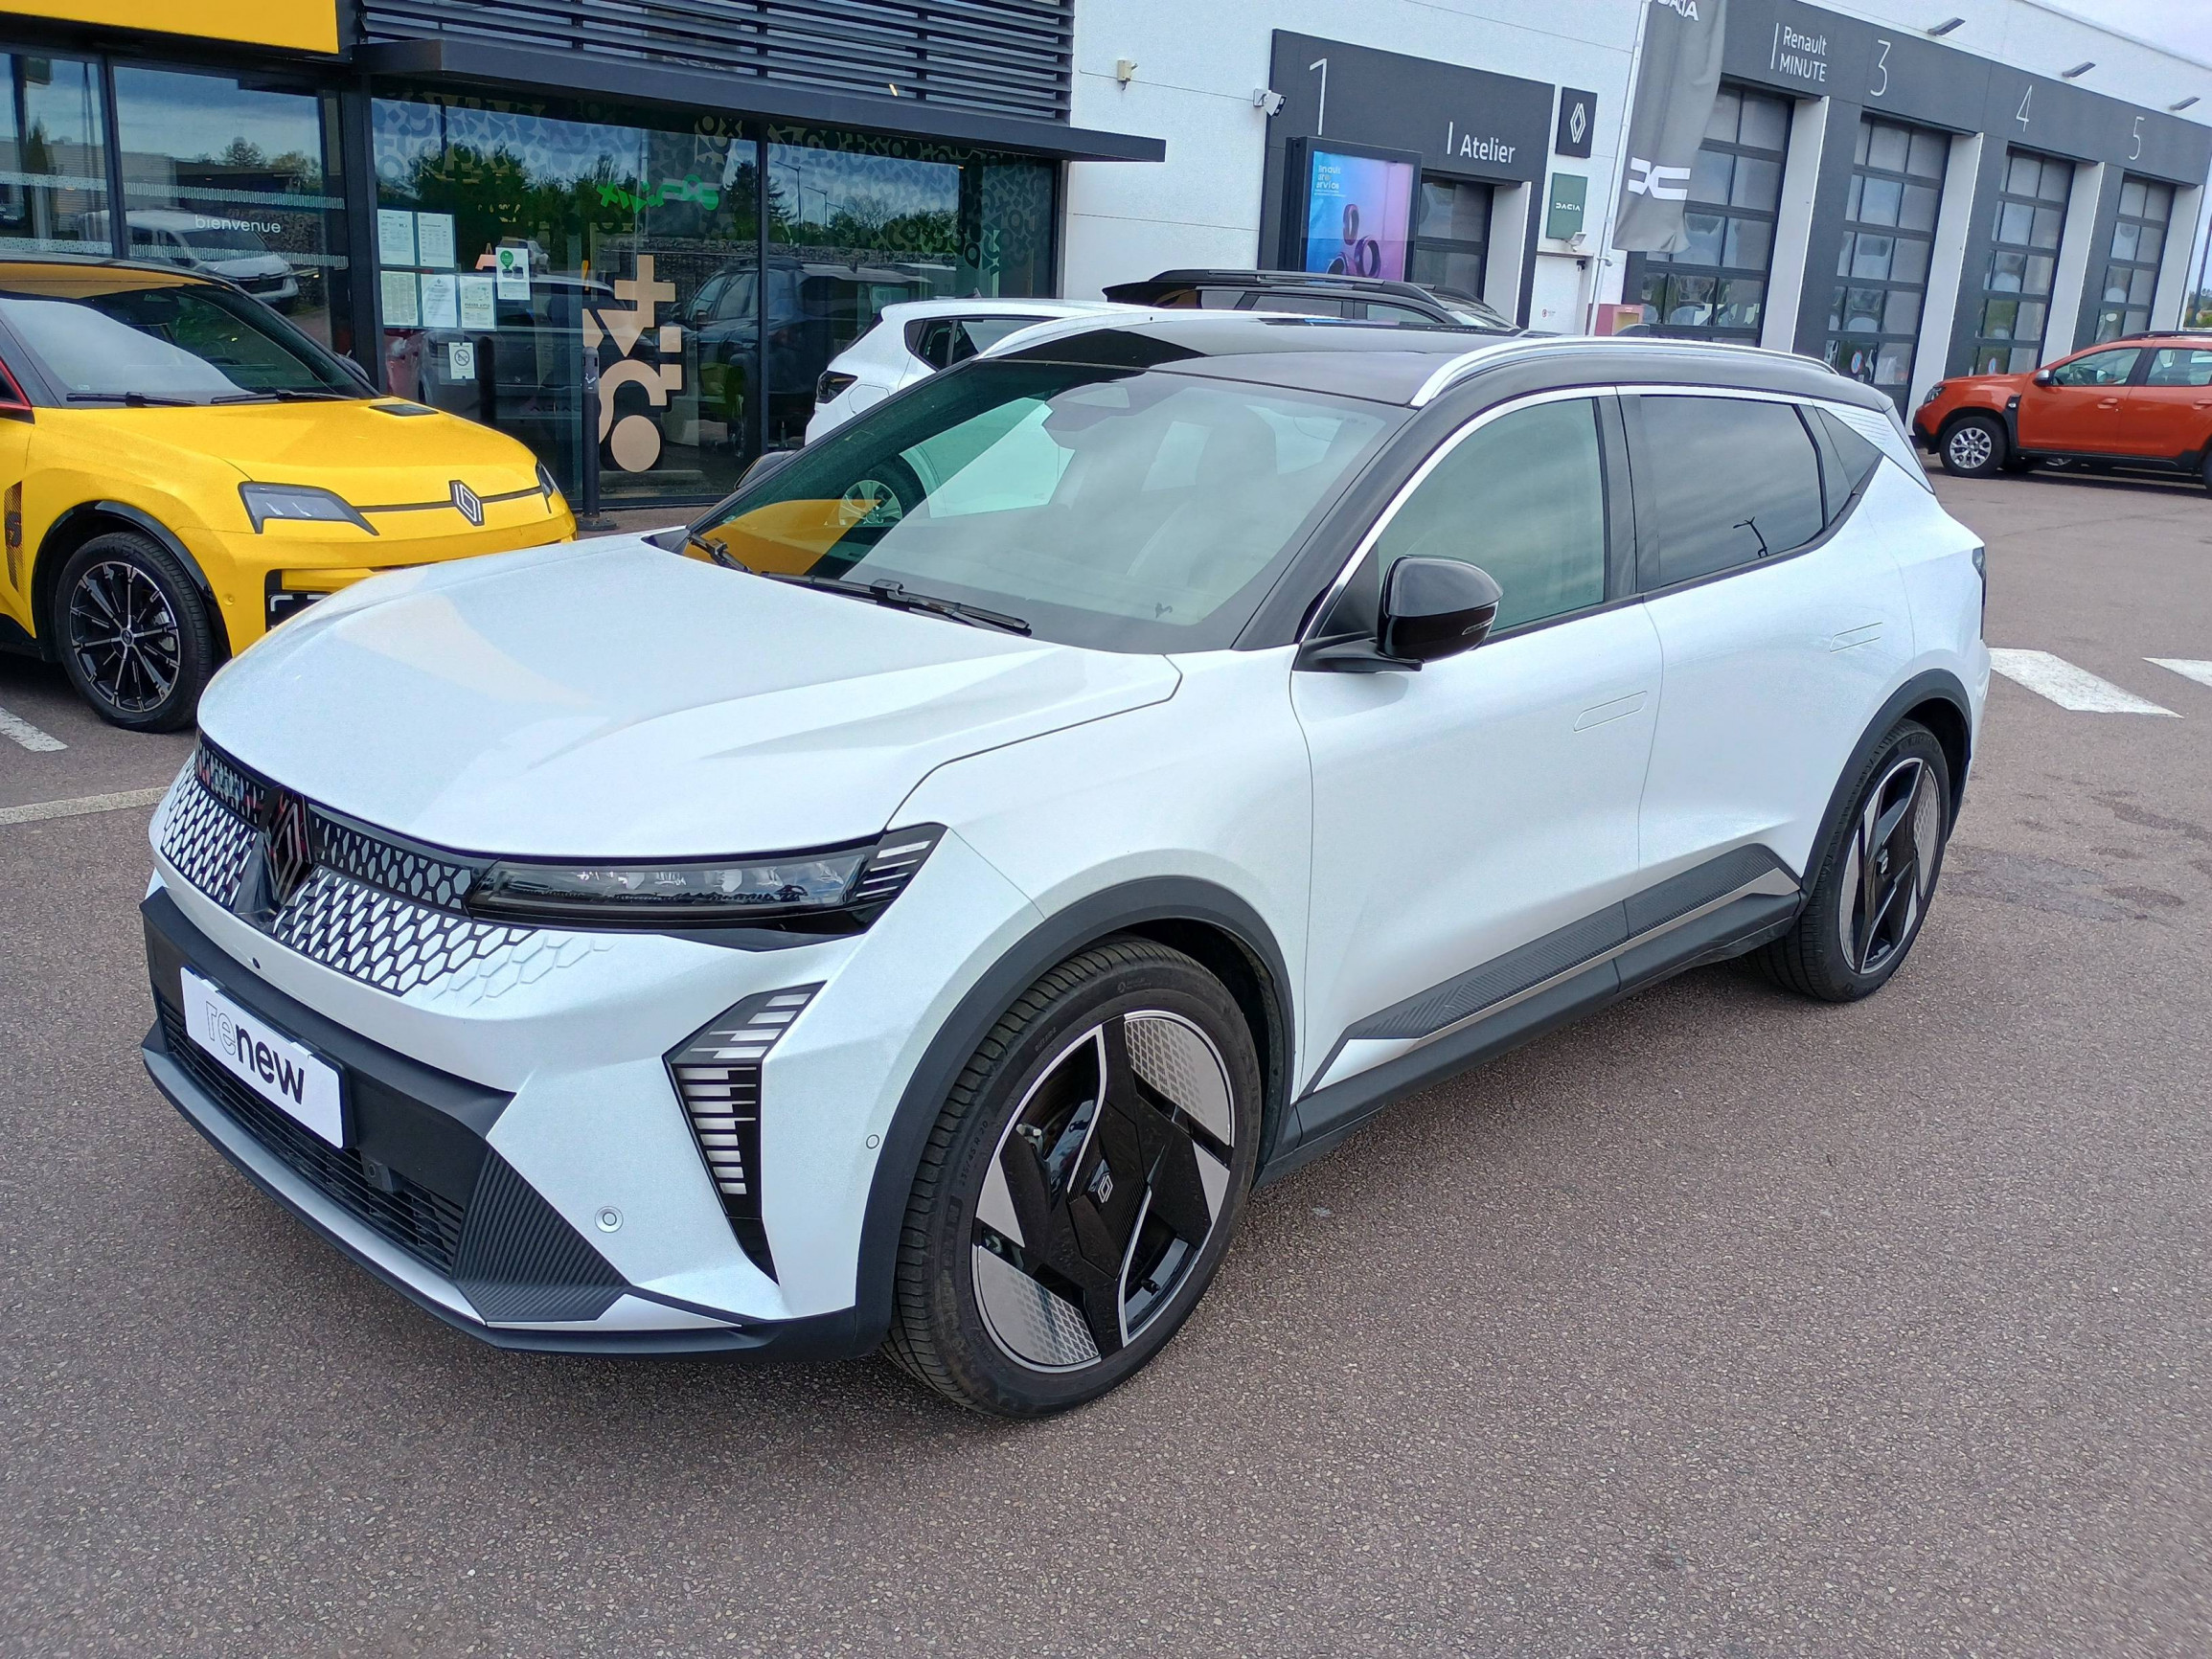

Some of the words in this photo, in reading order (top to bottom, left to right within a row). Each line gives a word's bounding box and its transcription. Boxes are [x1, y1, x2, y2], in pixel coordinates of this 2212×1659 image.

[1783, 26, 1827, 57] Renault
[1779, 53, 1828, 82] MINUTE
[1870, 39, 1891, 97] 3
[1309, 57, 1328, 136] 1
[2016, 84, 2033, 133] 4
[1459, 133, 1516, 164] Atelier
[2128, 116, 2146, 161] 5
[194, 214, 282, 234] bienvenue
[1555, 202, 1581, 212] DACIA
[205, 1000, 305, 1105] renew
